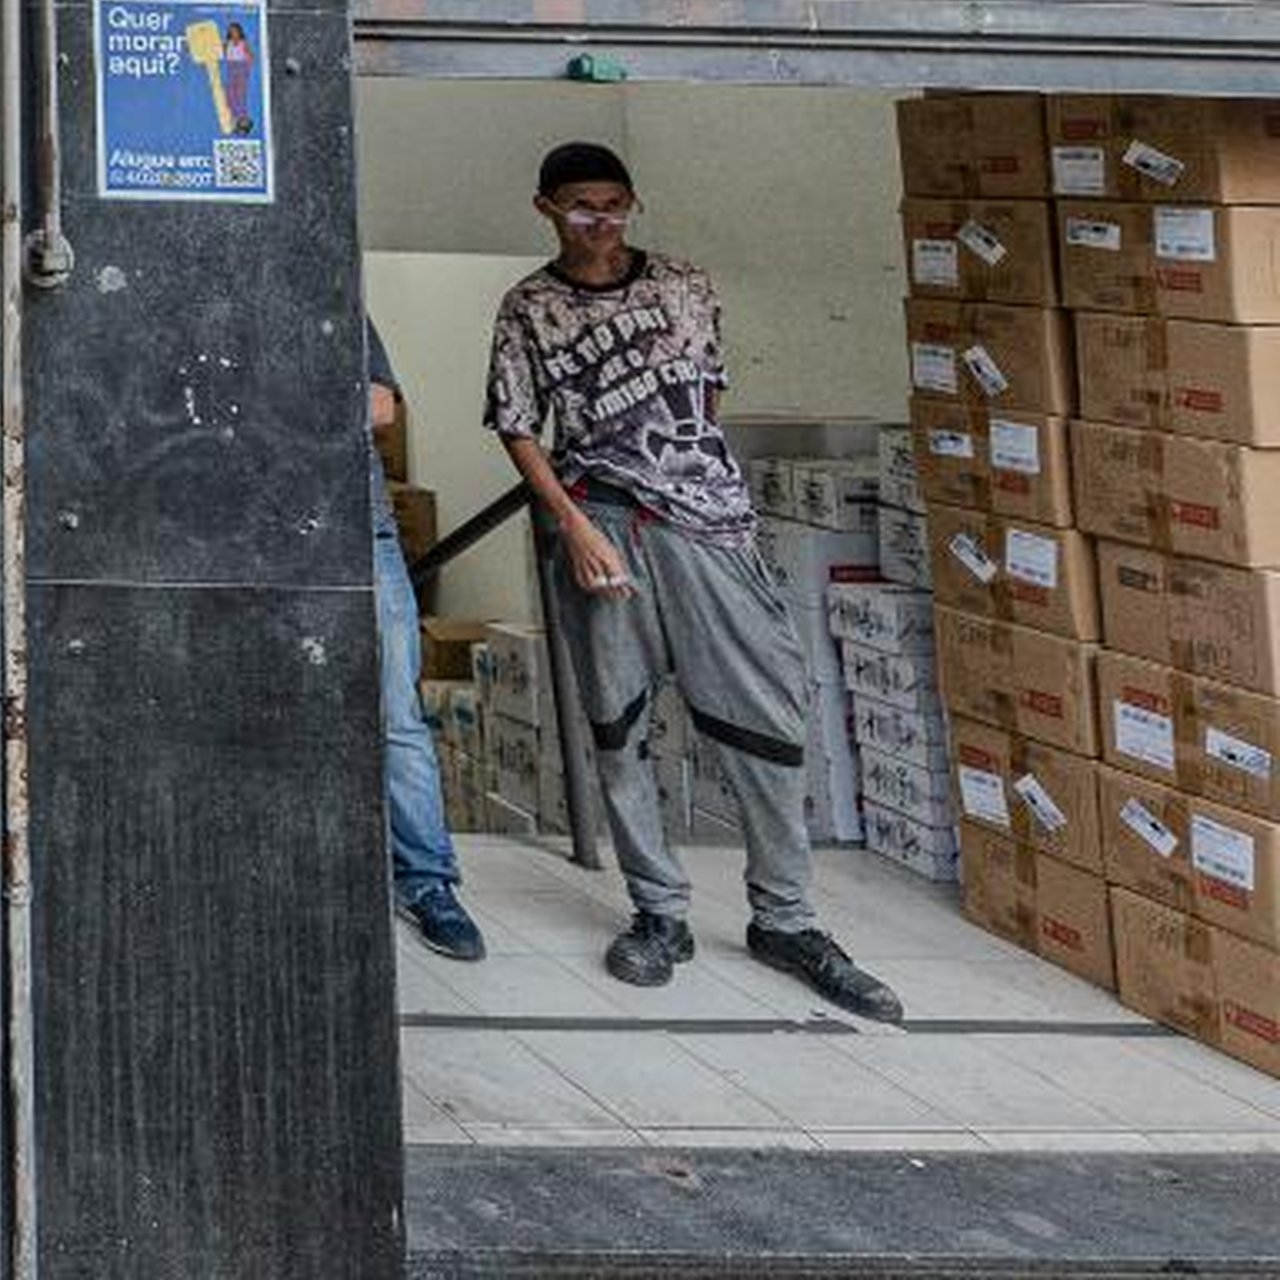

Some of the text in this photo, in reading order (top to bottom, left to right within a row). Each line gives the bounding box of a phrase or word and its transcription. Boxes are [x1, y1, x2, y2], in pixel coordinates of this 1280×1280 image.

[109, 6, 175, 32] Quer
[109, 35, 188, 52] morar
[109, 53, 181, 79] aqui?
